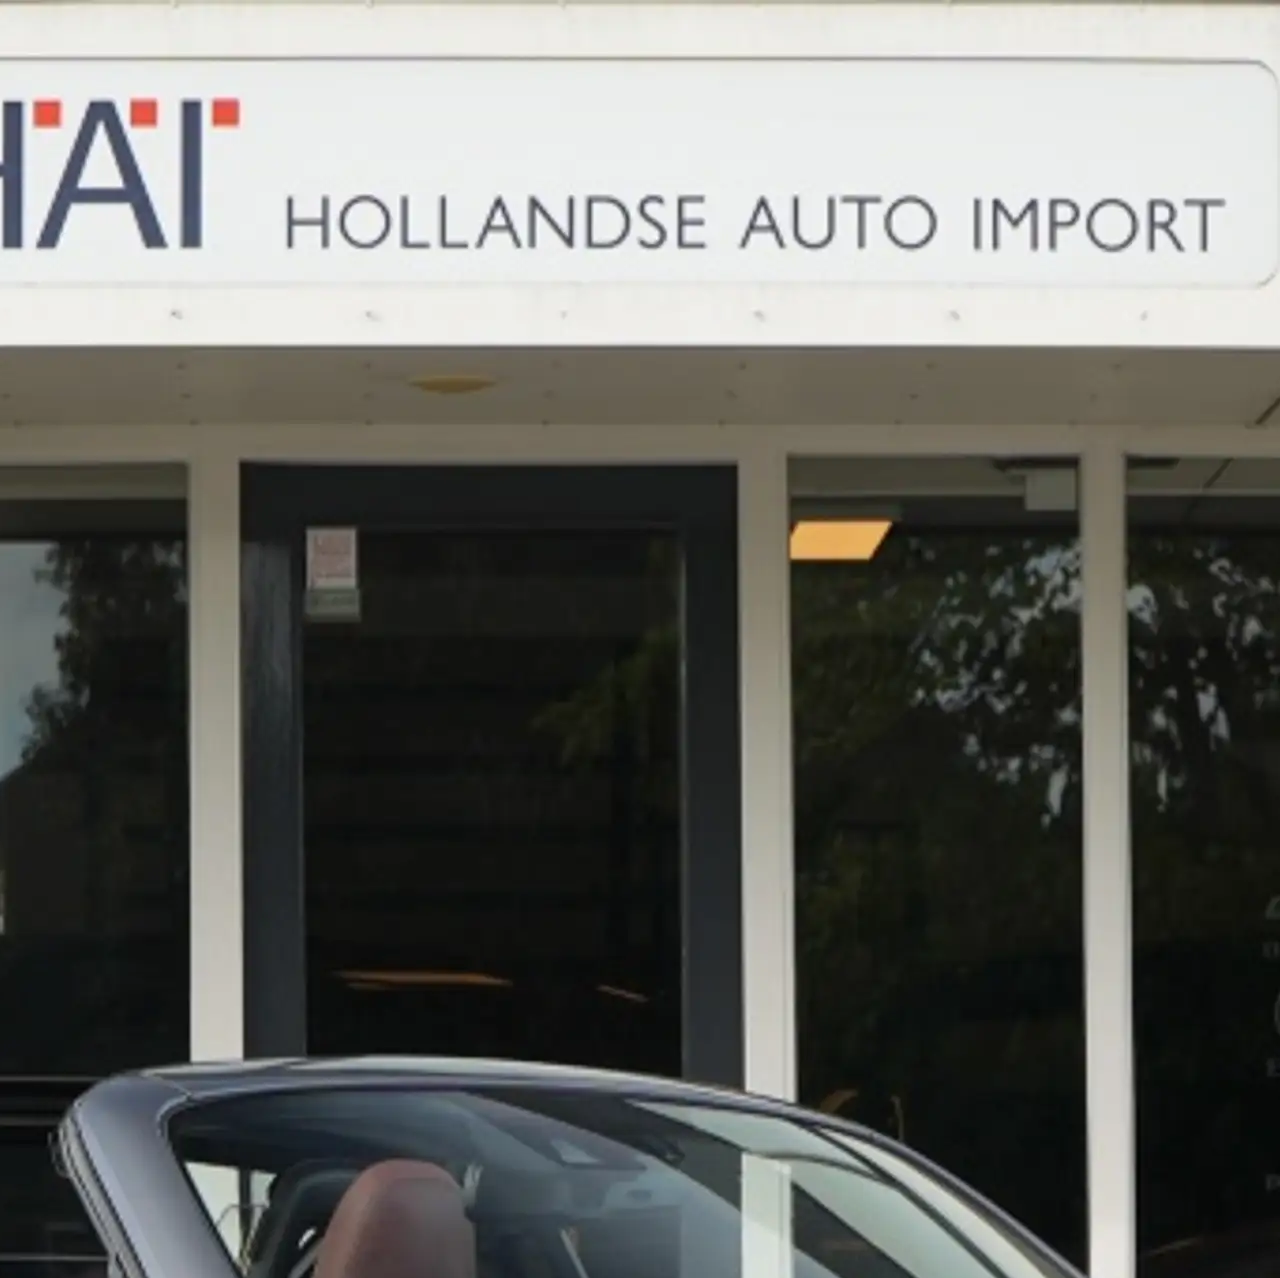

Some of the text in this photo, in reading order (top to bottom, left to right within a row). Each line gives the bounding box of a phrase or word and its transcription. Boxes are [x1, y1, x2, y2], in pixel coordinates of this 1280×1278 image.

[286, 194, 1226, 253] HOLLANDSE AUTO IMPORT
